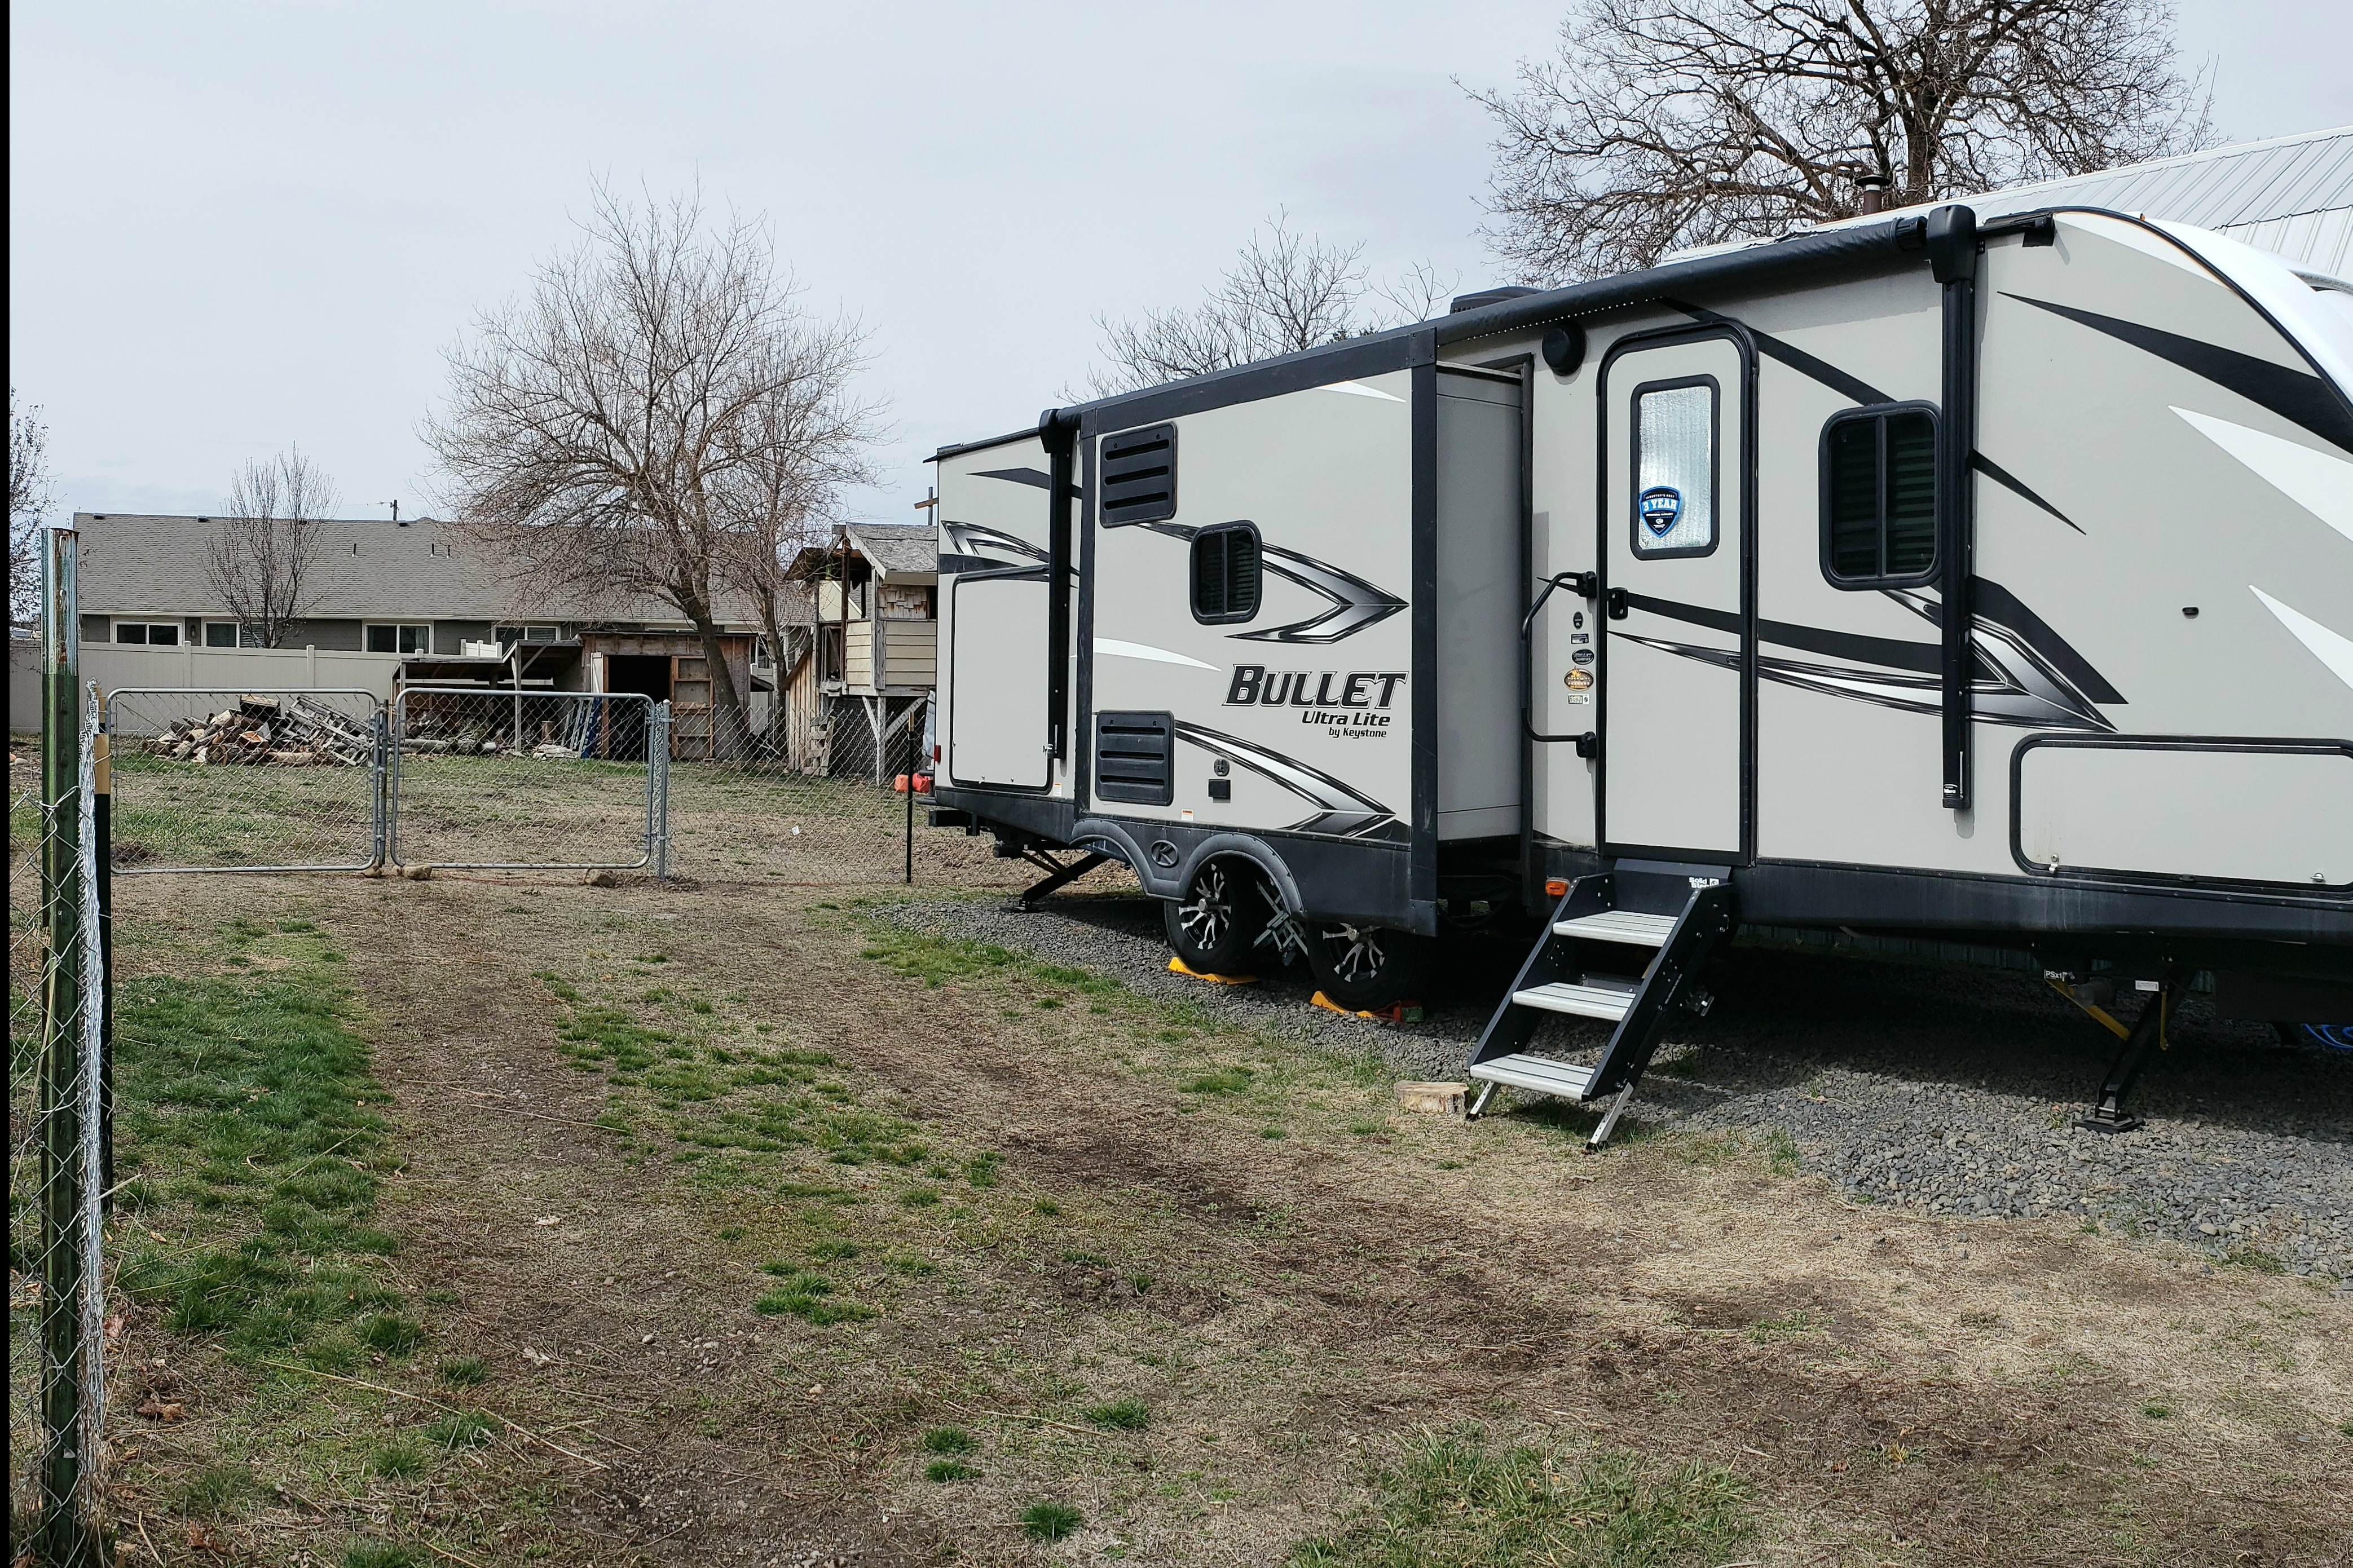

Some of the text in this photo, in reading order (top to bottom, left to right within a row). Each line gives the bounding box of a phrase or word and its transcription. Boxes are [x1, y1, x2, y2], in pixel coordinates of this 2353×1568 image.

[1643, 498, 1677, 511] 3 YEAR
[1221, 664, 1409, 709] BULLET
[1302, 711, 1391, 727] Ultra Lite
[1328, 727, 1387, 739] by Keystone
